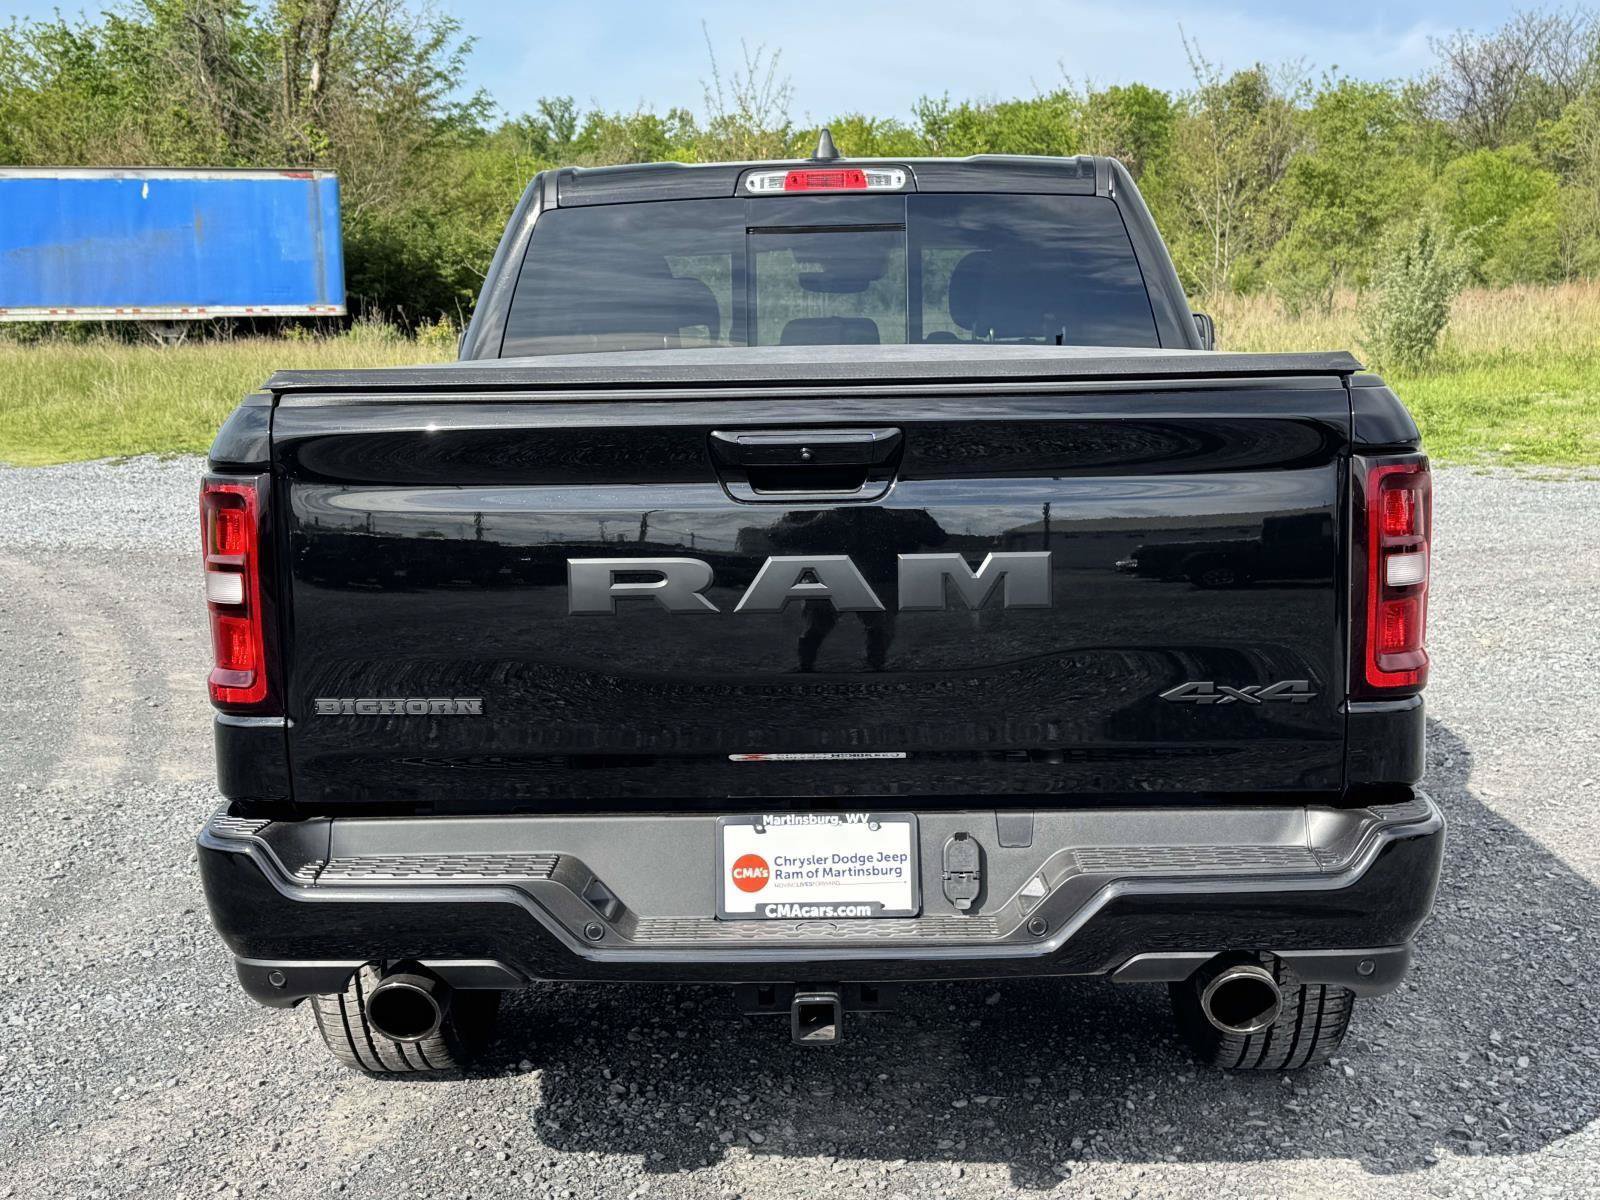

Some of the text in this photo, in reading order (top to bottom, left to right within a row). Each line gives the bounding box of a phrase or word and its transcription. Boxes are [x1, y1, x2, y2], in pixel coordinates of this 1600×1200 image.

[567, 551, 1053, 615] RAM
[1159, 680, 1318, 704] 4x4
[314, 698, 483, 715] BIGHORN
[762, 813, 870, 827] Martinsburg, WV
[774, 852, 908, 868] Chrysler Dodge Jeep
[733, 867, 768, 879] CMA's
[775, 865, 902, 880] Ram of Martinsburg
[764, 903, 871, 918] CMAcars.com
